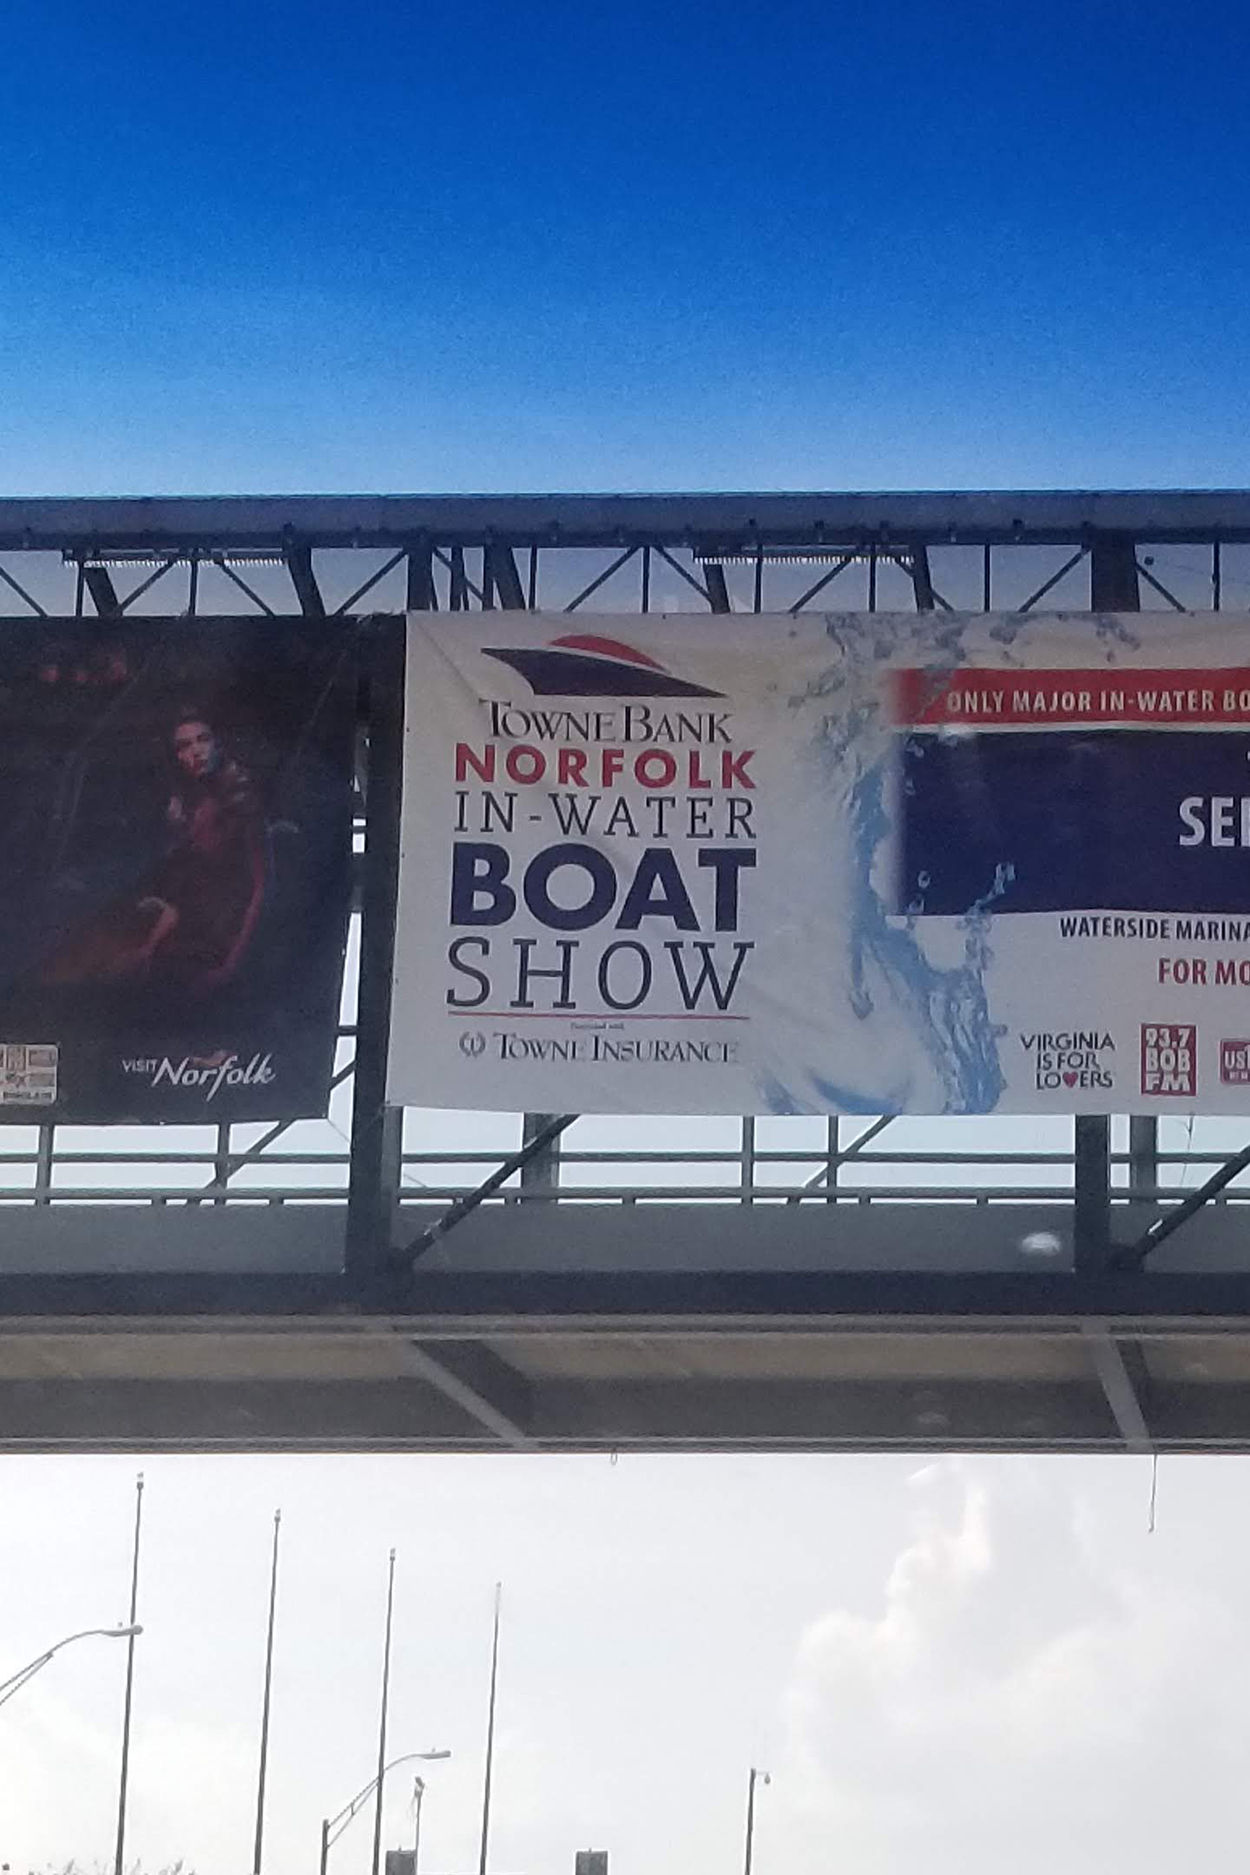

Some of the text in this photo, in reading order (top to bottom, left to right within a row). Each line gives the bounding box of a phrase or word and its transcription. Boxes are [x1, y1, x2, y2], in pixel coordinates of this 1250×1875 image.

[947, 690, 1003, 713] ONLY
[1012, 690, 1091, 712] MAJOR
[1101, 690, 1214, 712] IN-WATER
[454, 743, 757, 789] NORFOLK
[454, 791, 757, 838] IN-WATER
[450, 842, 757, 932] BOAT
[1059, 917, 1170, 940] WATERSIDE
[446, 936, 755, 1011] SHOW
[1158, 957, 1206, 986] FOR
[1020, 1031, 1116, 1051] VIRGINIA
[1145, 1028, 1191, 1048] 93.7
[1037, 1051, 1100, 1071] IS FOR
[1145, 1048, 1191, 1072] BOB
[121, 1053, 276, 1102] VISIT Norfolk
[1145, 1072, 1191, 1092] FM
